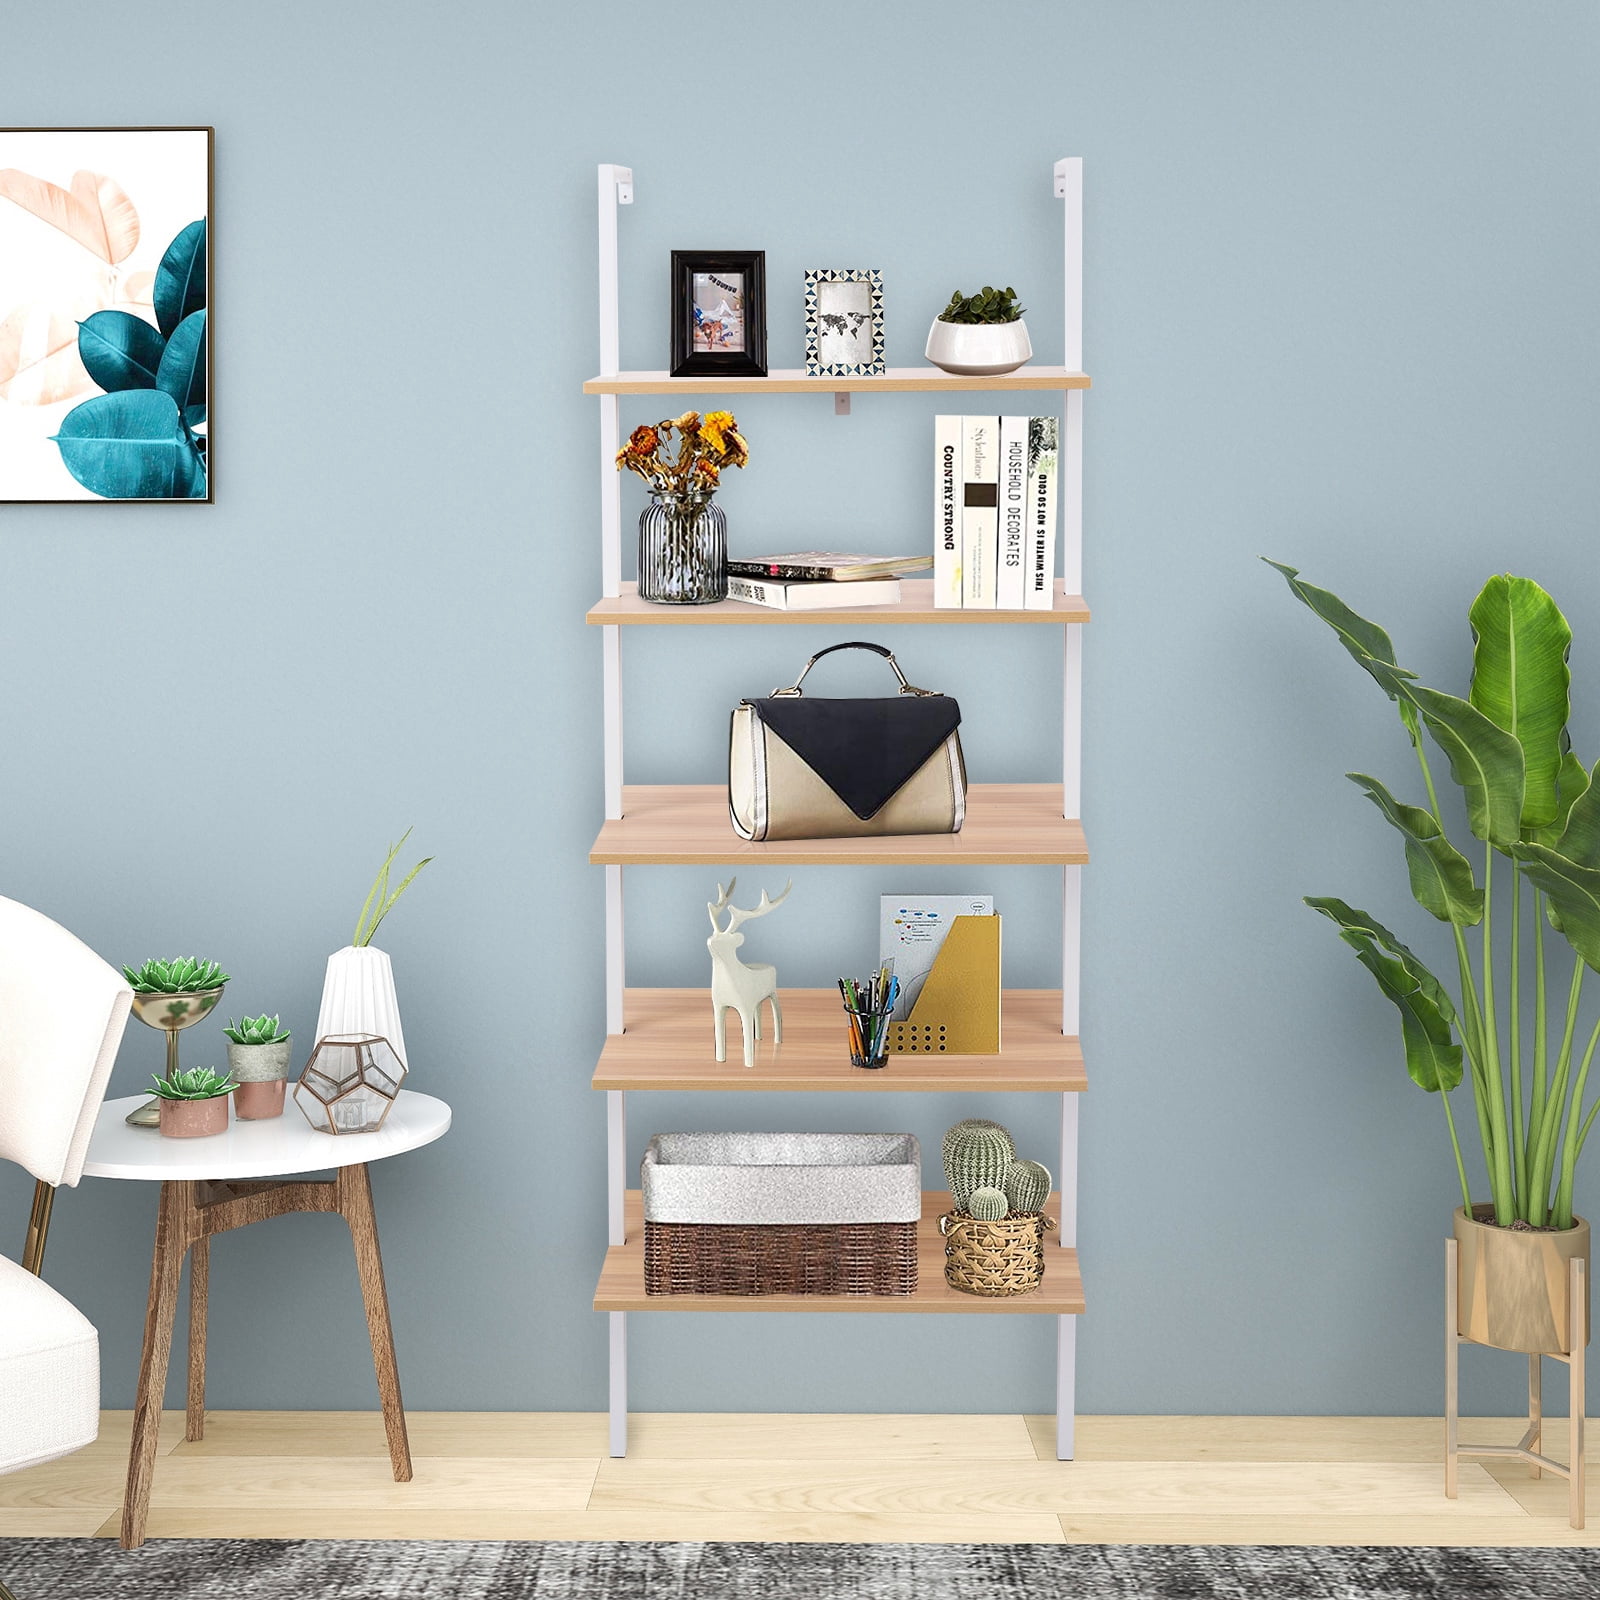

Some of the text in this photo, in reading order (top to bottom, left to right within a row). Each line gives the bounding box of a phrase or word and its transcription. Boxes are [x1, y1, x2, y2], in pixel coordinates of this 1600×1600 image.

[943, 445, 955, 551] COUNTRY STRONG
[1006, 441, 1023, 567] HOUSEHOLD DECORATES
[1035, 474, 1048, 591] THIS WINTER IS NOT SO COLD
